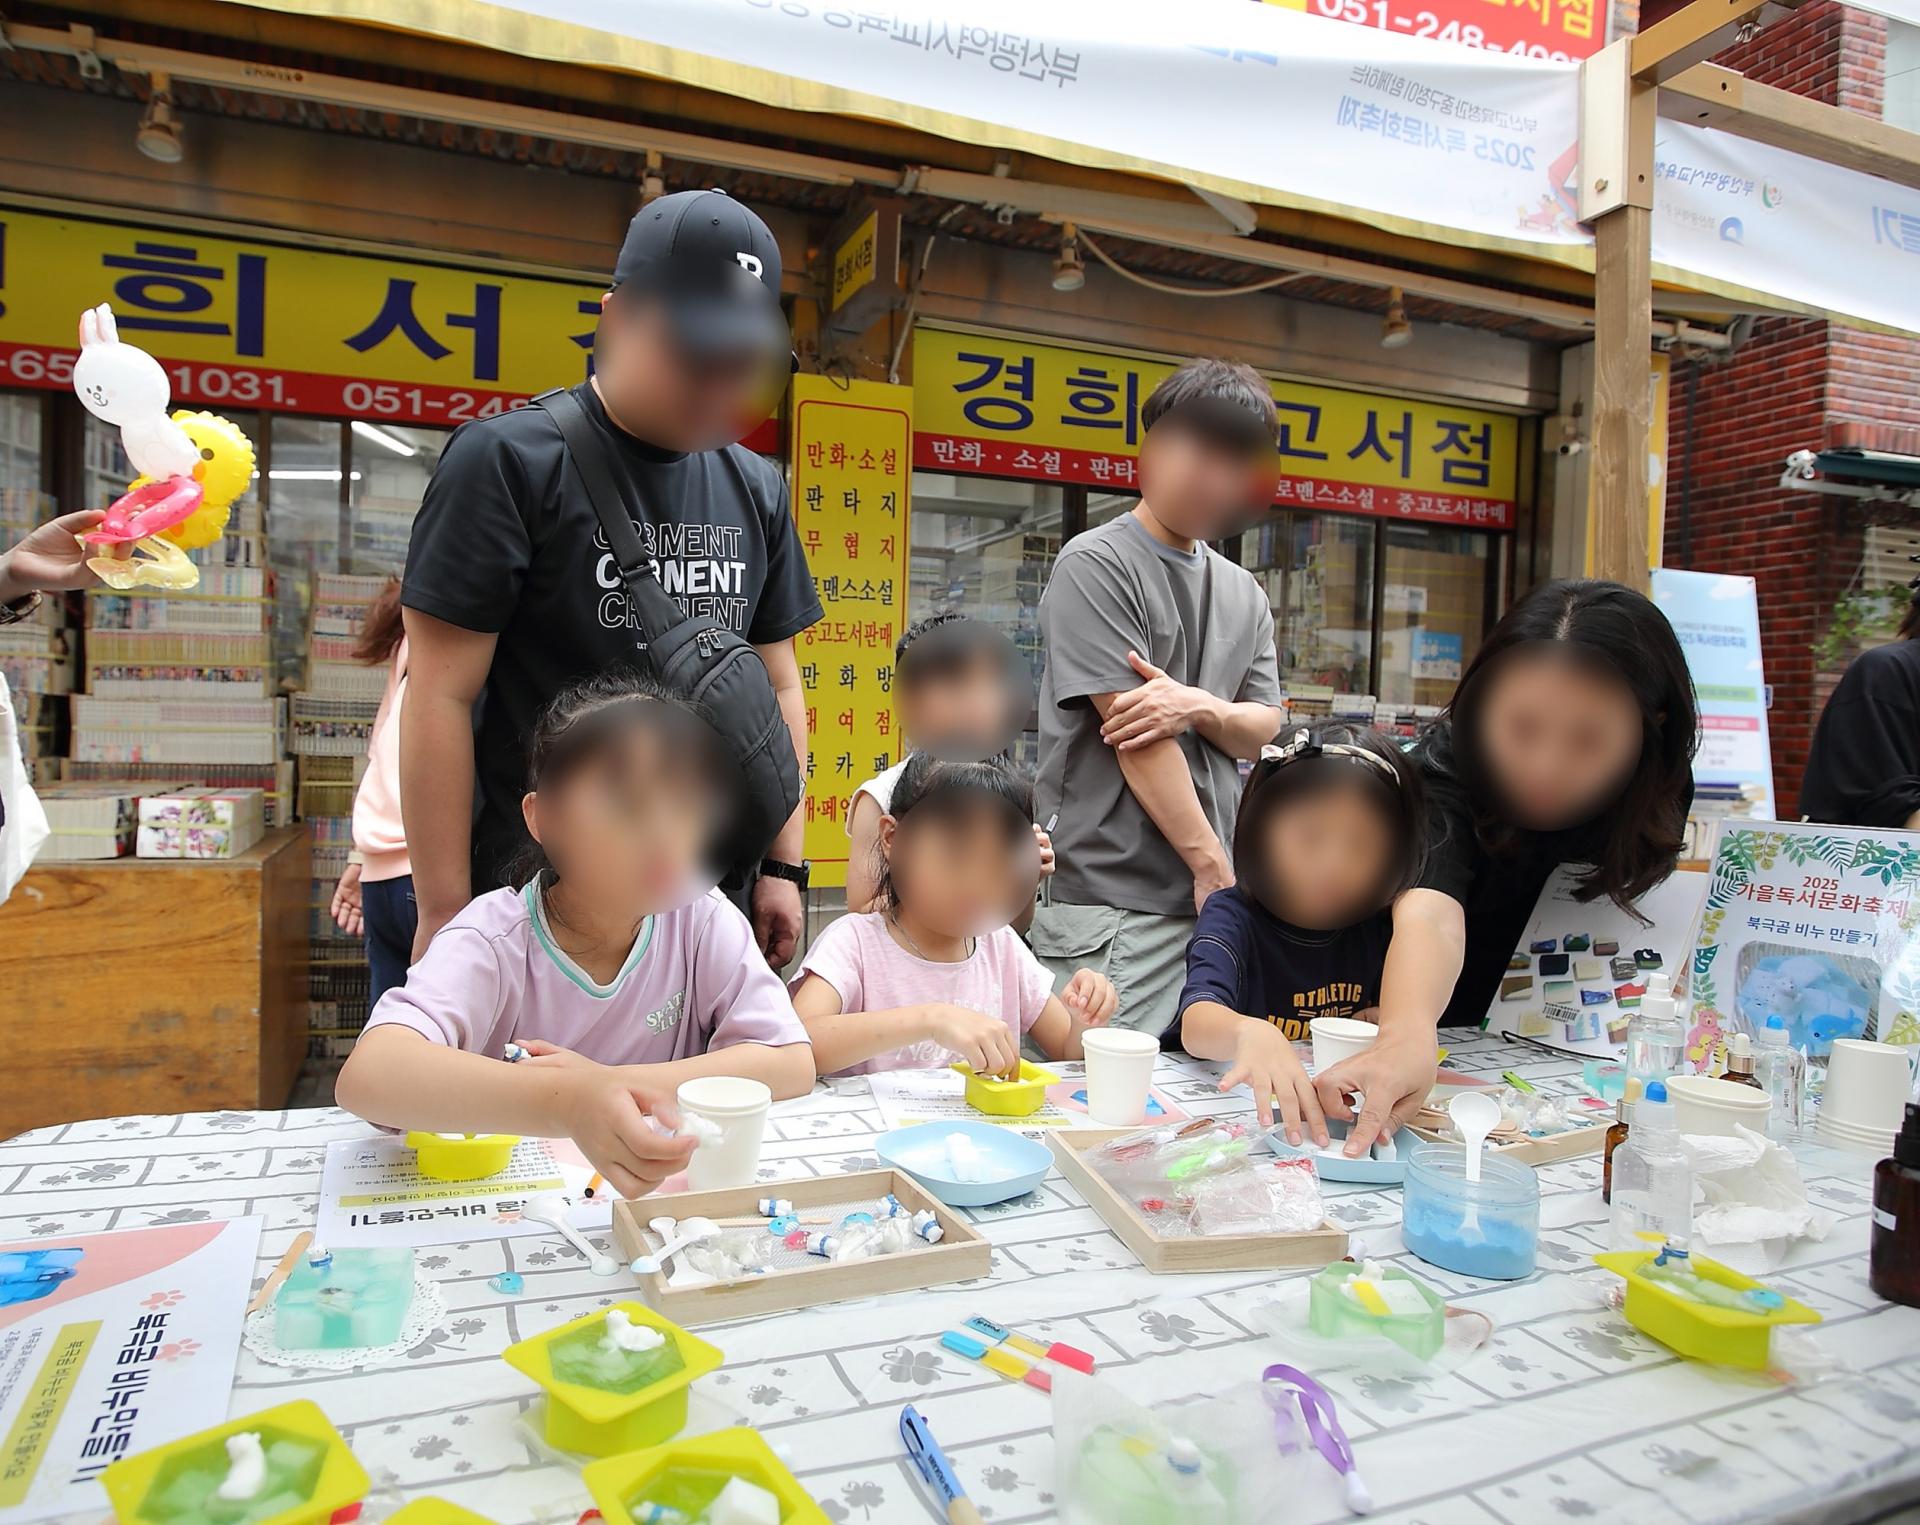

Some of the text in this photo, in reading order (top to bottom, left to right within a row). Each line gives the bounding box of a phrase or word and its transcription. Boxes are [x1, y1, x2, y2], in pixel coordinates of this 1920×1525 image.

[932, 440, 1506, 522] 만화 소설 판타 로맨스소설 중고도서판매
[803, 621, 892, 648] 중고도서판매
[1802, 876, 1839, 891] 2025
[1737, 883, 1909, 921] 가을독서문화축제
[1747, 916, 1879, 947] 북극곰 비누 만들기
[1293, 983, 1362, 1007] ATHLETIC
[117, 1312, 171, 1365] 북극곰
